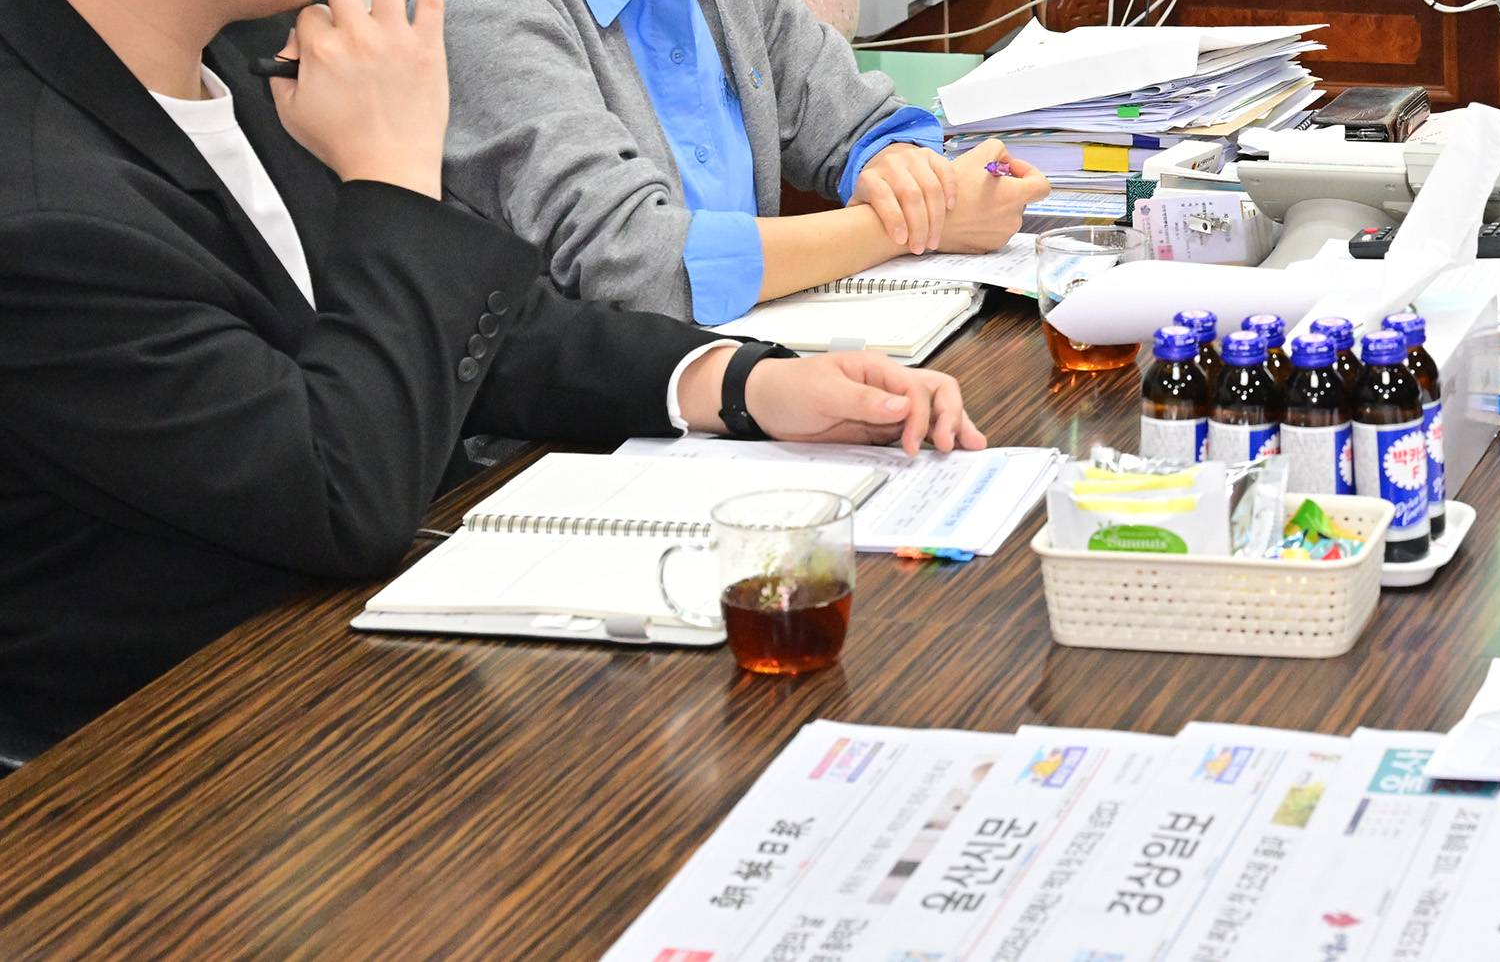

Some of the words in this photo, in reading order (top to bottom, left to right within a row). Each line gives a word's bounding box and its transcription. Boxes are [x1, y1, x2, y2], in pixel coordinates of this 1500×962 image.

[1412, 466, 1420, 479] F
[921, 817, 1038, 914] 울산신문
[1105, 811, 1215, 916] 경상일보
